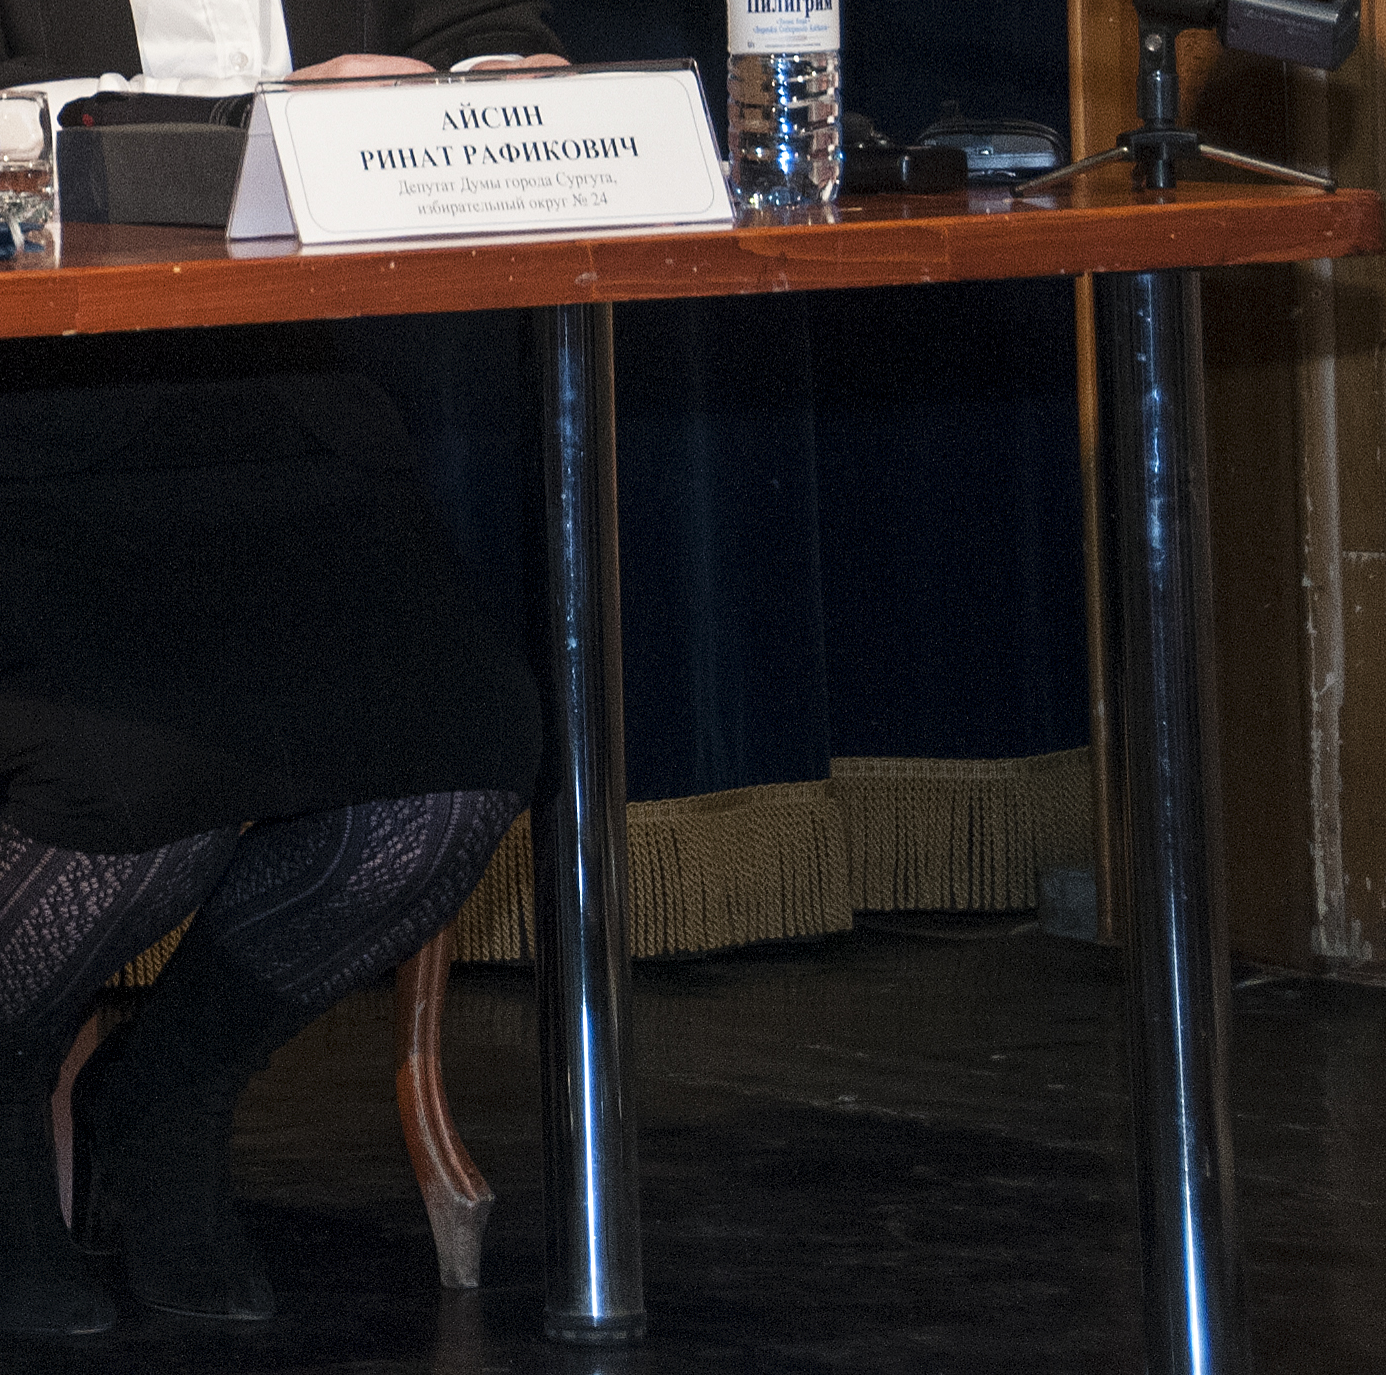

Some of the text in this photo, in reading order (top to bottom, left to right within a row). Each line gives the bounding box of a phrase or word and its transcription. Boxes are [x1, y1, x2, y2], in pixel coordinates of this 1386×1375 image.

[442, 102, 544, 131] АЙСИН
[359, 136, 639, 171] РИНАТ РАФИКОВИЧ
[399, 171, 618, 196] Депутат Думы города Сургута,
[417, 192, 608, 217] избирательный округ № 24
